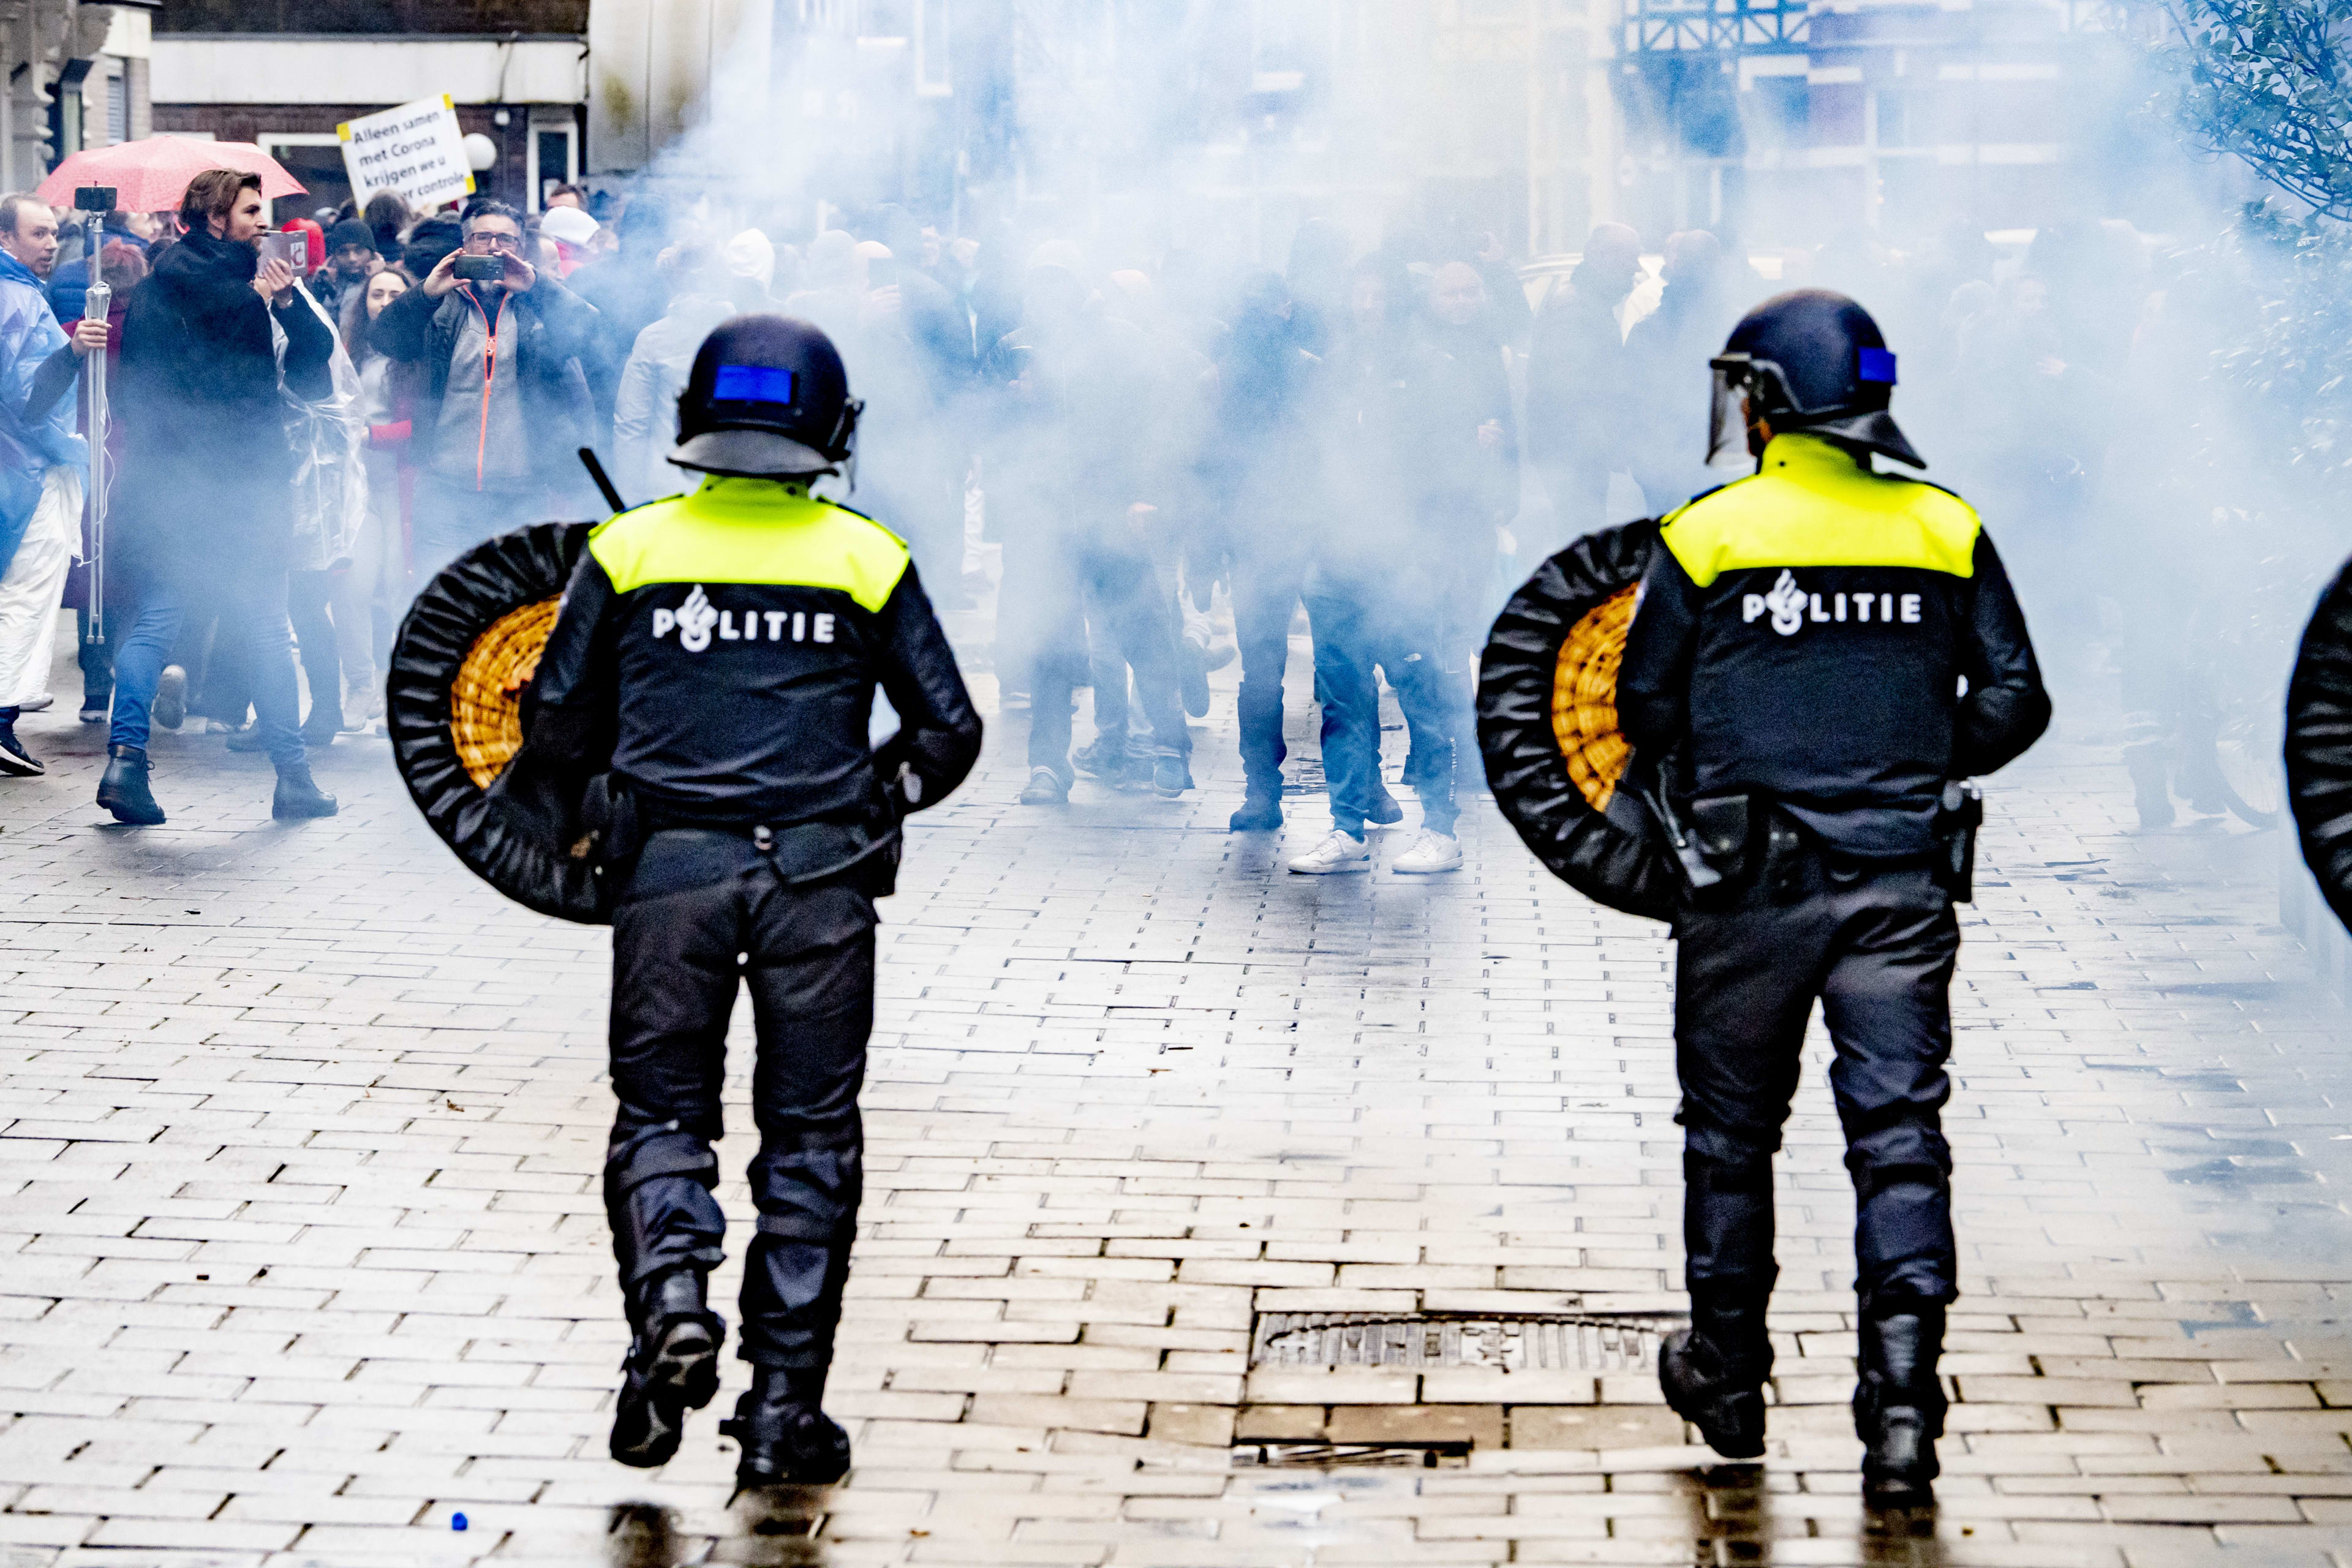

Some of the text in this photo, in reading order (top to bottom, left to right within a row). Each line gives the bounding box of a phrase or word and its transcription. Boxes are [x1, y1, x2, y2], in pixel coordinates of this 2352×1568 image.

[355, 112, 439, 144] Alleen samen
[359, 137, 436, 167] met Corona
[364, 156, 446, 187] krijgen we u
[418, 172, 464, 195] controle
[652, 583, 835, 652] POLITIE
[1743, 568, 1922, 636] POLITIE
